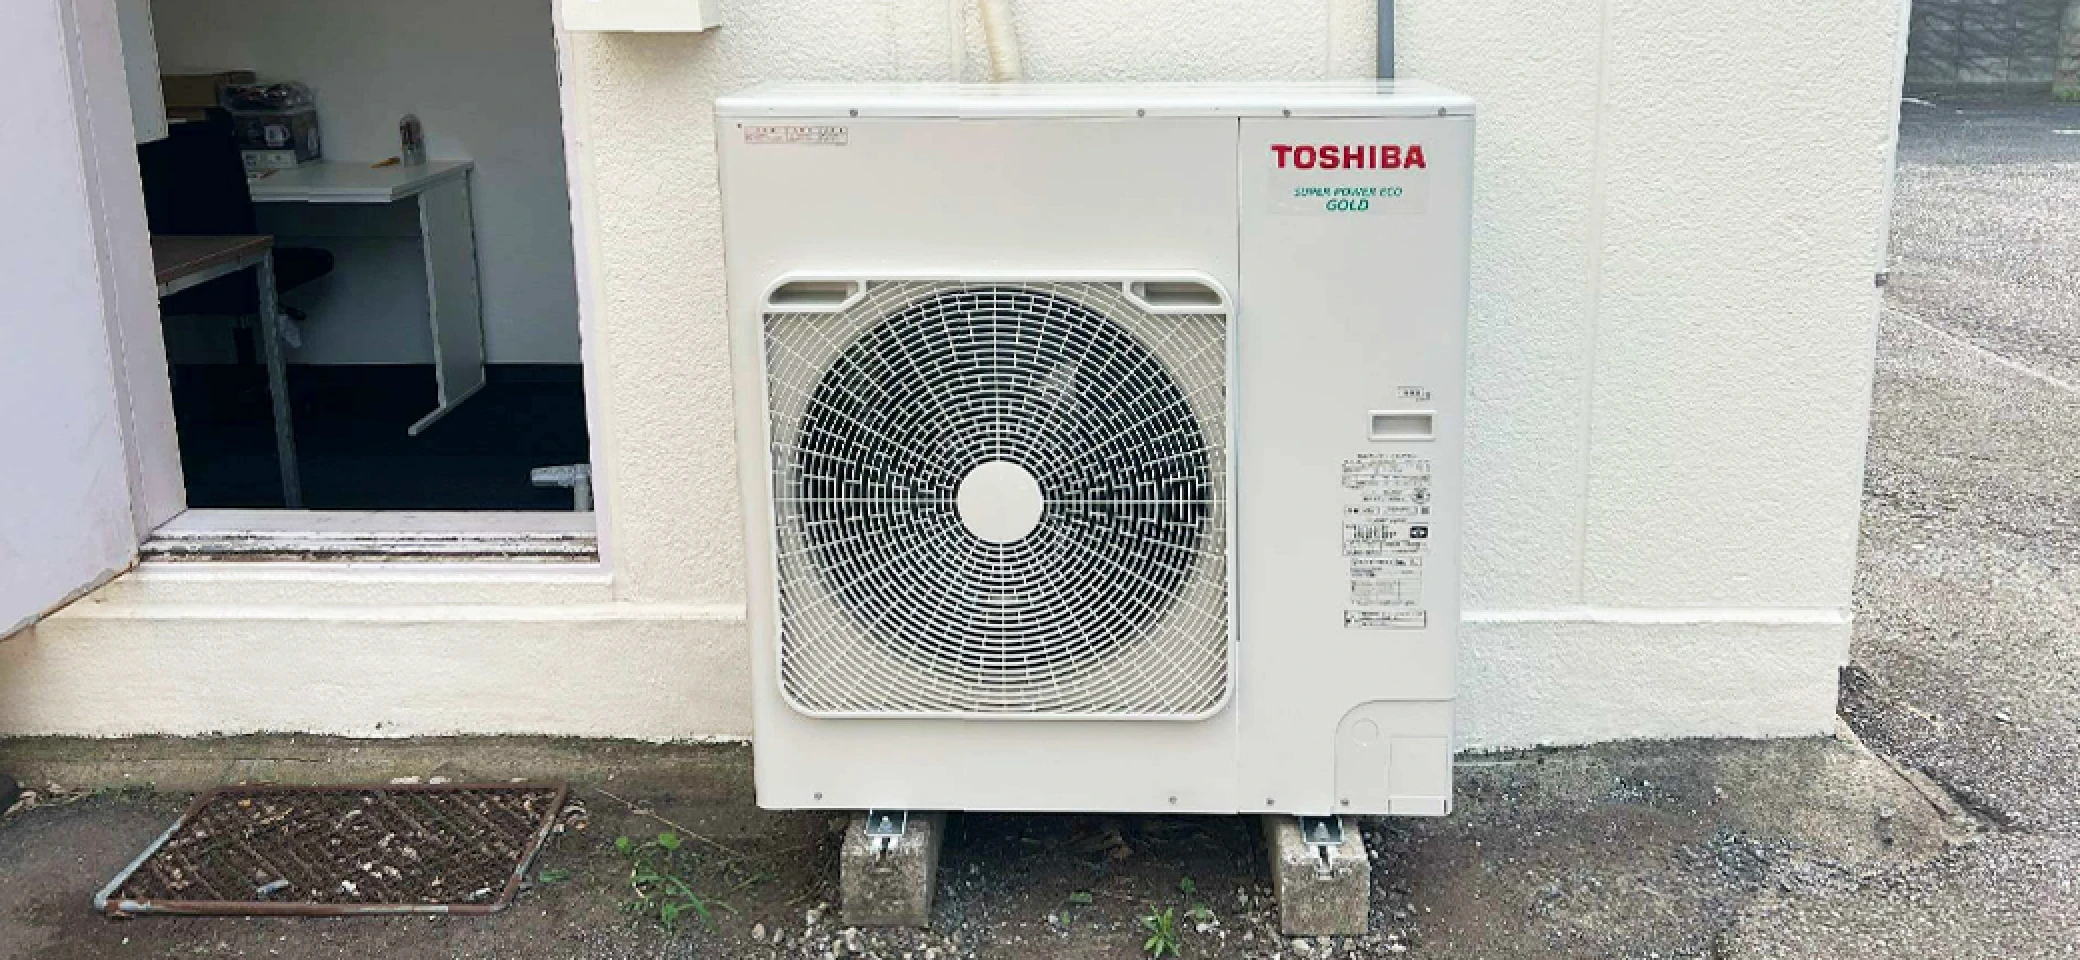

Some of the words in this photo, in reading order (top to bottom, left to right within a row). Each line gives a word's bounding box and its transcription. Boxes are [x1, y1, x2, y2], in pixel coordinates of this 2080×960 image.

[1270, 143, 1426, 170] TOSHIBA
[1294, 186, 1331, 197] SUPER
[1326, 198, 1369, 211] GOLD
